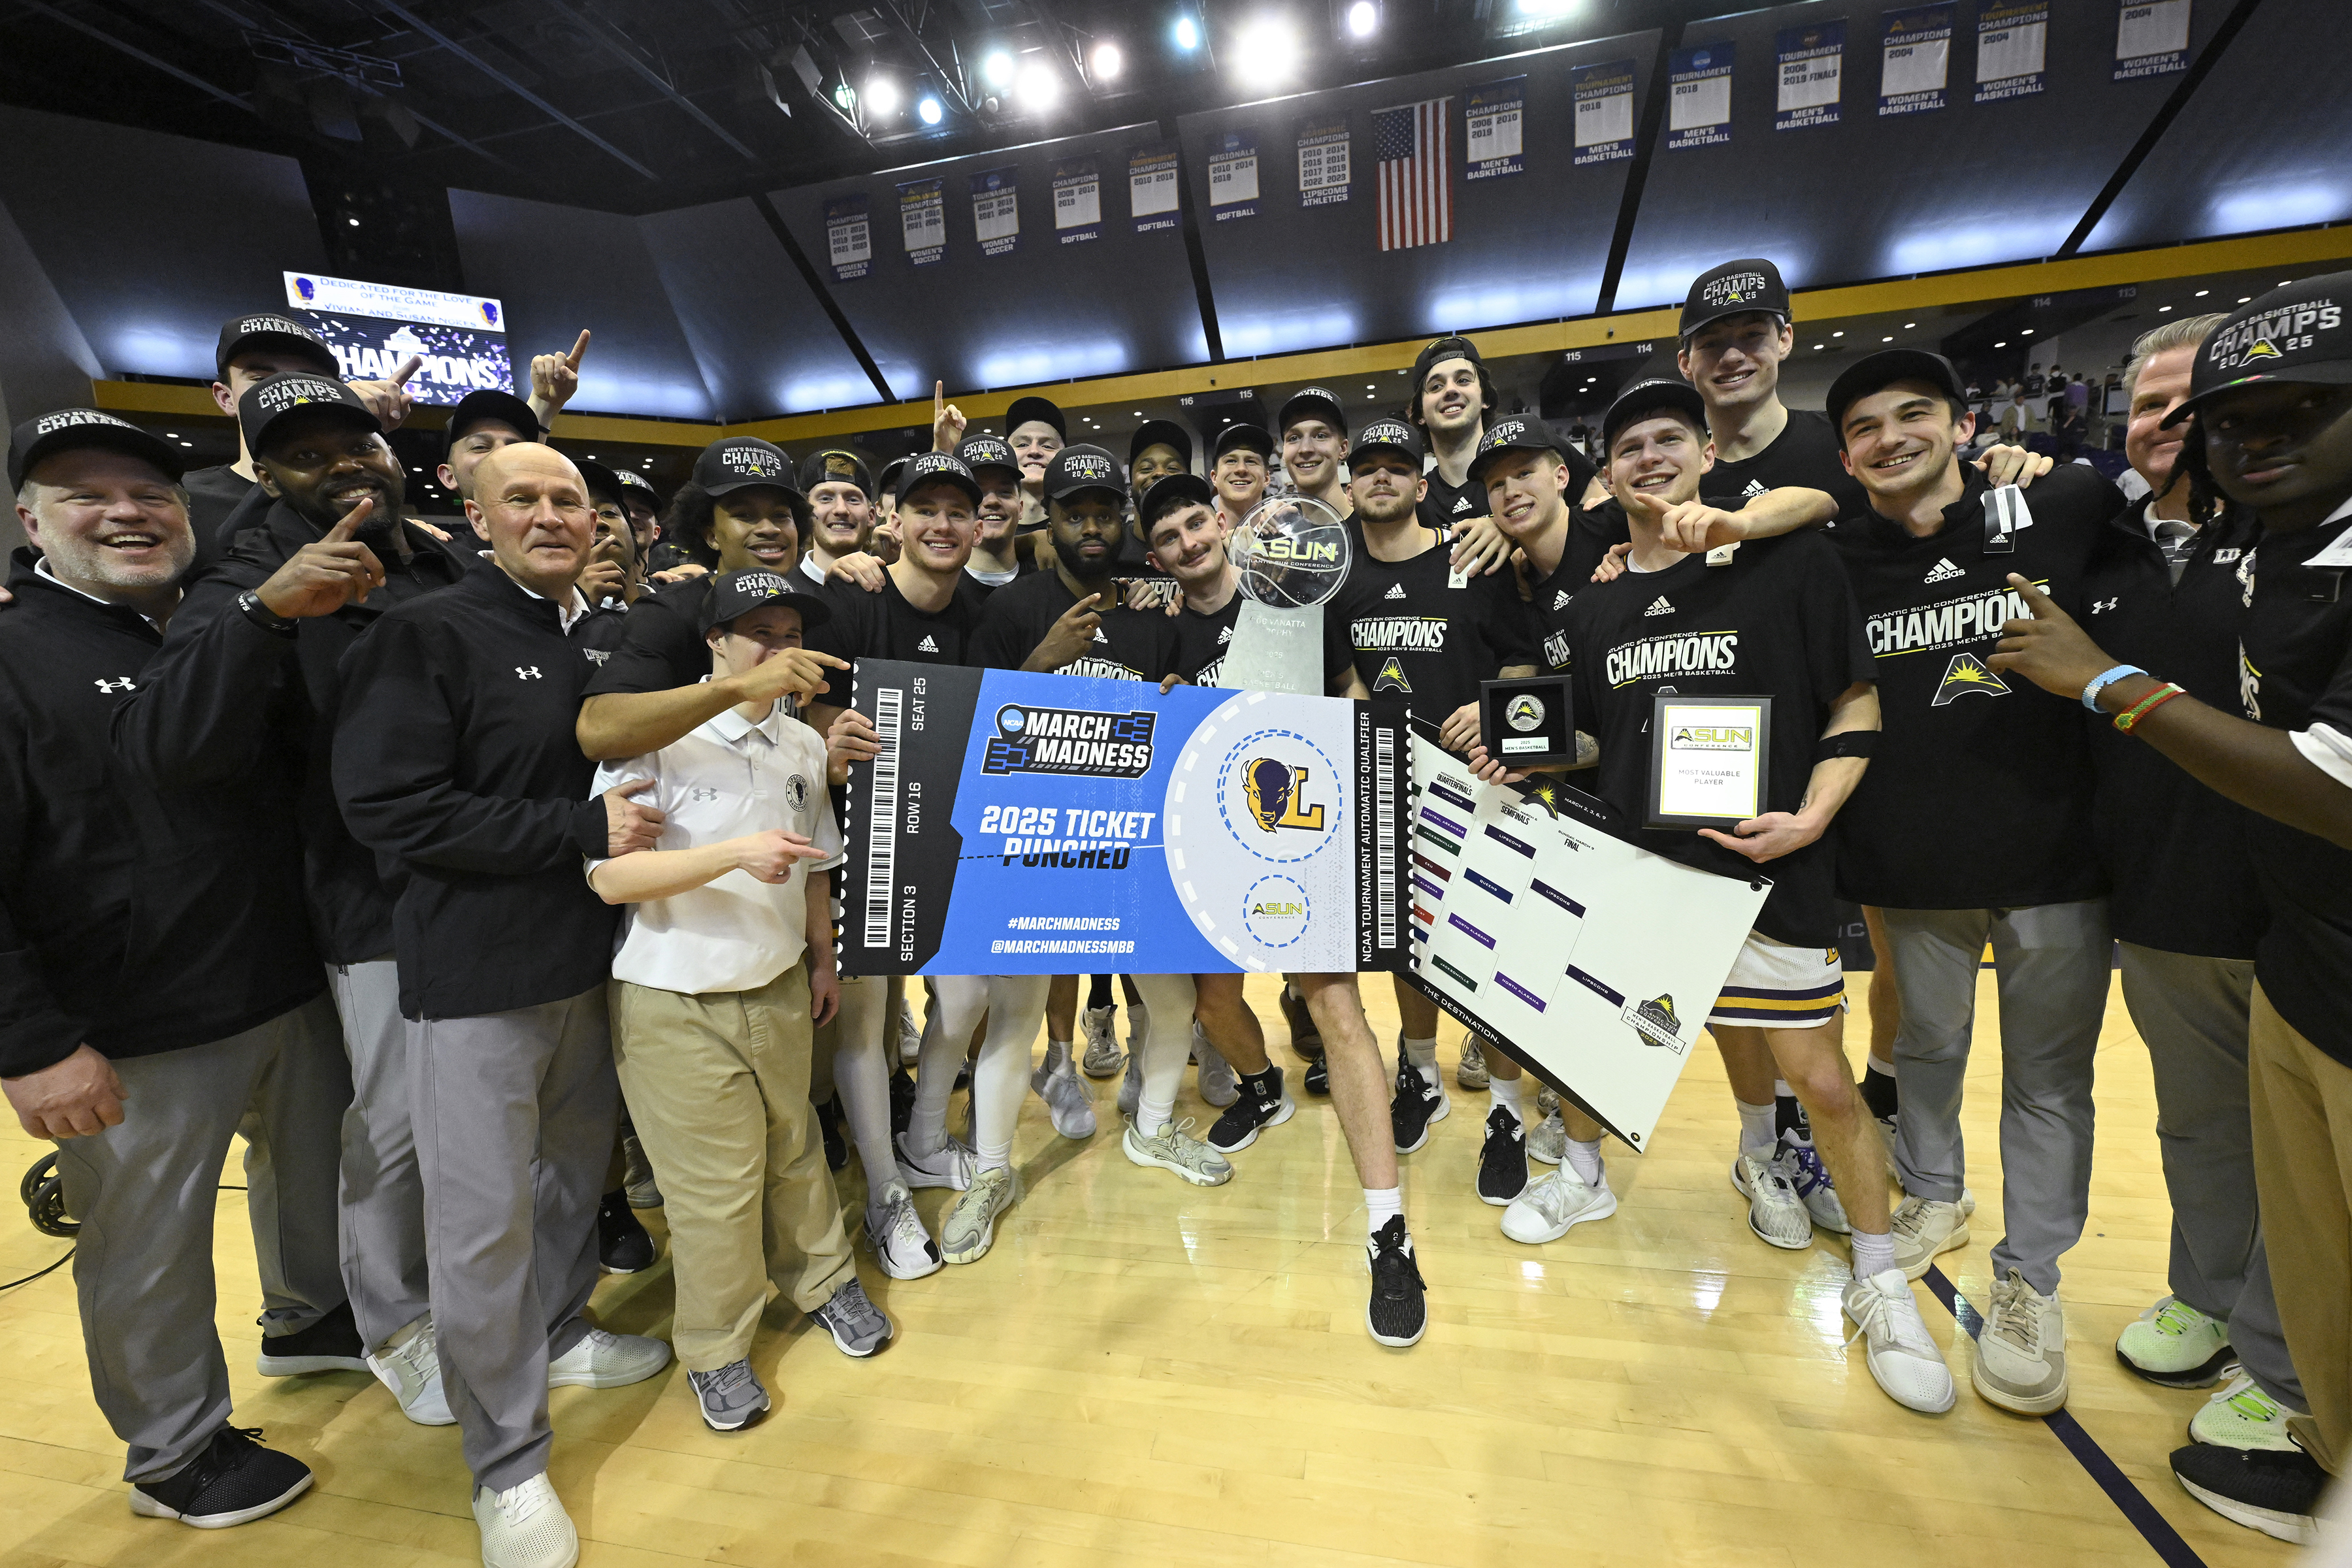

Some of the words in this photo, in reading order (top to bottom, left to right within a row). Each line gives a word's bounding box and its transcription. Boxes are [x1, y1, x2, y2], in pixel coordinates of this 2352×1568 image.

[1978, 10, 2048, 31] CHAMPIONS
[2125, 7, 2152, 20] 2004
[1884, 28, 1951, 46] CHAMPIONS
[1984, 33, 2009, 44] 2004
[1779, 44, 1842, 63] TOURNAMENT
[1889, 47, 1913, 59] 2004
[2123, 52, 2180, 69] WOMEN'S
[1671, 66, 1731, 82] TOURNAMENT
[1809, 69, 1837, 82] FINALS
[2114, 61, 2187, 80] BASKETBALL
[1575, 75, 1632, 91] TOURNAMENT
[1983, 74, 2037, 91] WOMEN'S
[1575, 83, 1633, 100] CHAMPIONS
[1887, 91, 1938, 105] WOMEN'S
[1974, 82, 2044, 102] BASKETBALL
[1466, 100, 1522, 117] CHAMPIONS
[1791, 106, 1824, 119] MEN'S
[1879, 99, 1945, 116] BASKETBALL
[1776, 113, 1840, 130] BASKETBALL
[1298, 132, 1350, 147] CHAMPIONS
[1684, 127, 1715, 138] MEN'S
[1326, 144, 1345, 154] 2014
[1589, 142, 1618, 154] MEN'S
[1669, 133, 1729, 149] BASKETBALL
[1210, 148, 1255, 163] REGIONALS
[1481, 158, 1509, 169] MEN'S
[1575, 149, 1633, 165] BASKETBALL
[1130, 161, 1177, 175] CHAMPIONS
[1235, 160, 1254, 170] 2014
[1303, 168, 1322, 178] 2017
[1467, 164, 1523, 180] BASKETBALL
[1053, 173, 1099, 188] CHAMPIONS
[1303, 178, 1322, 187] 2022
[973, 186, 1016, 201] TOURNAMENT
[1303, 186, 1347, 199] LIPSCOMB
[1303, 193, 1348, 206] ATHLETICS
[901, 197, 943, 211] CHAMPIONS
[827, 213, 868, 227] CHAMPIONS
[1216, 208, 1255, 221] SOFTBALL
[1137, 220, 1175, 232] SOFTBALL
[982, 236, 1015, 250] WOMEN'S
[1061, 231, 1098, 244] SOFTBALL
[910, 246, 943, 258] WOMEN'S
[986, 244, 1013, 255] SOCCER
[837, 261, 868, 272] WOMEN'S
[913, 254, 941, 265] SOCCER
[840, 269, 866, 279] SOCCER
[1707, 277, 1725, 288] MEN'S
[1727, 272, 1761, 281] BASKETBALL
[320, 278, 389, 293] DEDICATED
[393, 288, 415, 297] FOR
[418, 291, 440, 300] THE
[444, 293, 472, 304] LOVE
[1703, 276, 1766, 301] CHAMPS
[2118, 287, 2136, 298] 113
[405, 296, 438, 308] GAME
[1712, 297, 1723, 306] 20
[1745, 291, 1757, 300] 25
[2033, 297, 2051, 308] 114
[324, 302, 364, 315] VIVIAN
[368, 309, 393, 318] AND
[397, 312, 434, 323] SUSAN
[2248, 299, 2334, 324] BASKETBALL
[266, 318, 306, 333] BASKETBALL
[2209, 306, 2342, 363] CHAMPS
[1565, 351, 1582, 361] 115
[1637, 343, 1652, 353] 114
[2218, 353, 2239, 370] 20
[2285, 335, 2314, 351] 25
[259, 382, 280, 396] MEN'S
[282, 379, 330, 387] BASKETBALL
[1239, 389, 1253, 399] 115
[258, 384, 342, 409] CHAMPS
[1180, 397, 1194, 406] 116
[275, 402, 289, 412] 20
[39, 412, 70, 423] MEN'S
[1362, 427, 1409, 442] CHAMPS
[1480, 423, 1525, 453] CHAMPS
[745, 447, 777, 458] BASKETBALL
[964, 444, 1007, 457] CHAMPS
[723, 452, 781, 470] CHAMPS
[915, 458, 967, 476] CHAMPS
[1064, 459, 1111, 472] CHAMPS
[1452, 504, 1473, 514] adidas
[1924, 568, 1966, 584] adidas
[1644, 606, 1676, 617] adidas
[1868, 609, 1908, 621] ATLANTIC
[1911, 604, 1931, 613] SUN
[1934, 589, 2001, 609] CONFERENCE
[1350, 621, 1447, 648] CHAMPIONS
[1929, 642, 1953, 651] 2025
[1957, 634, 1987, 645] MEN'S
[1608, 642, 1635, 654] ATLANTIC
[1650, 632, 1698, 642] CONFERENCE
[1607, 636, 1738, 685] CHAMPIONS
[913, 678, 926, 695] 25
[912, 698, 925, 731] SEAT
[1024, 711, 1111, 740] MARCH
[1360, 711, 1369, 774] QUALIFIER
[1034, 739, 1150, 768] MADNESS
[909, 782, 921, 798] 16
[1437, 774, 1473, 796] QUARTERFINALS
[1442, 791, 1463, 804] LIPSCOMB
[1565, 798, 1582, 808] MARCH
[1361, 775, 1371, 845] AUTOMATIC
[1501, 806, 1529, 825] SEMIFINALS
[907, 804, 921, 833] ROW
[980, 806, 1058, 835] 2025
[1066, 809, 1156, 839] TICKET
[1424, 811, 1441, 822] CENTRAL
[1443, 820, 1464, 834] ARKANSAS
[1424, 830, 1453, 849] JACKSONVILLE
[1499, 834, 1522, 848] LIPSCOMB
[1564, 838, 1579, 852] FINAL
[1003, 838, 1130, 870] PUNCHED
[904, 885, 916, 895] 3
[1362, 846, 1371, 928] TOURNAMENT
[1480, 879, 1497, 892] QUEENS
[1546, 890, 1570, 906] LIPSCOMB
[901, 897, 916, 961] SECTION
[1008, 917, 1120, 931] #MARCHMADNESS
[1456, 919, 1469, 929] NORTH
[1470, 928, 1489, 943] ALABAMA
[990, 940, 1135, 954] @MARCHMADNESSMBB
[1362, 930, 1371, 962] NCAA
[1440, 962, 1469, 984] JACKSONVILLE
[1502, 979, 1517, 990] NORTH
[1518, 989, 1539, 1005] ALABAMA
[1582, 976, 1609, 994] LIPSCOMB
[1424, 985, 1439, 1000] THE
[1441, 998, 1499, 1044] DESTINATION.
[1640, 1007, 1664, 1023] ATLANTIC
[1640, 1011, 1675, 1033] CONFERENCE
[1626, 1016, 1678, 1050] CHAMPIONSHIP
[1633, 1013, 1646, 1024] MEN'S
[1648, 1021, 1676, 1043] BASKETBALL
[1641, 1033, 1658, 1045] 2025
